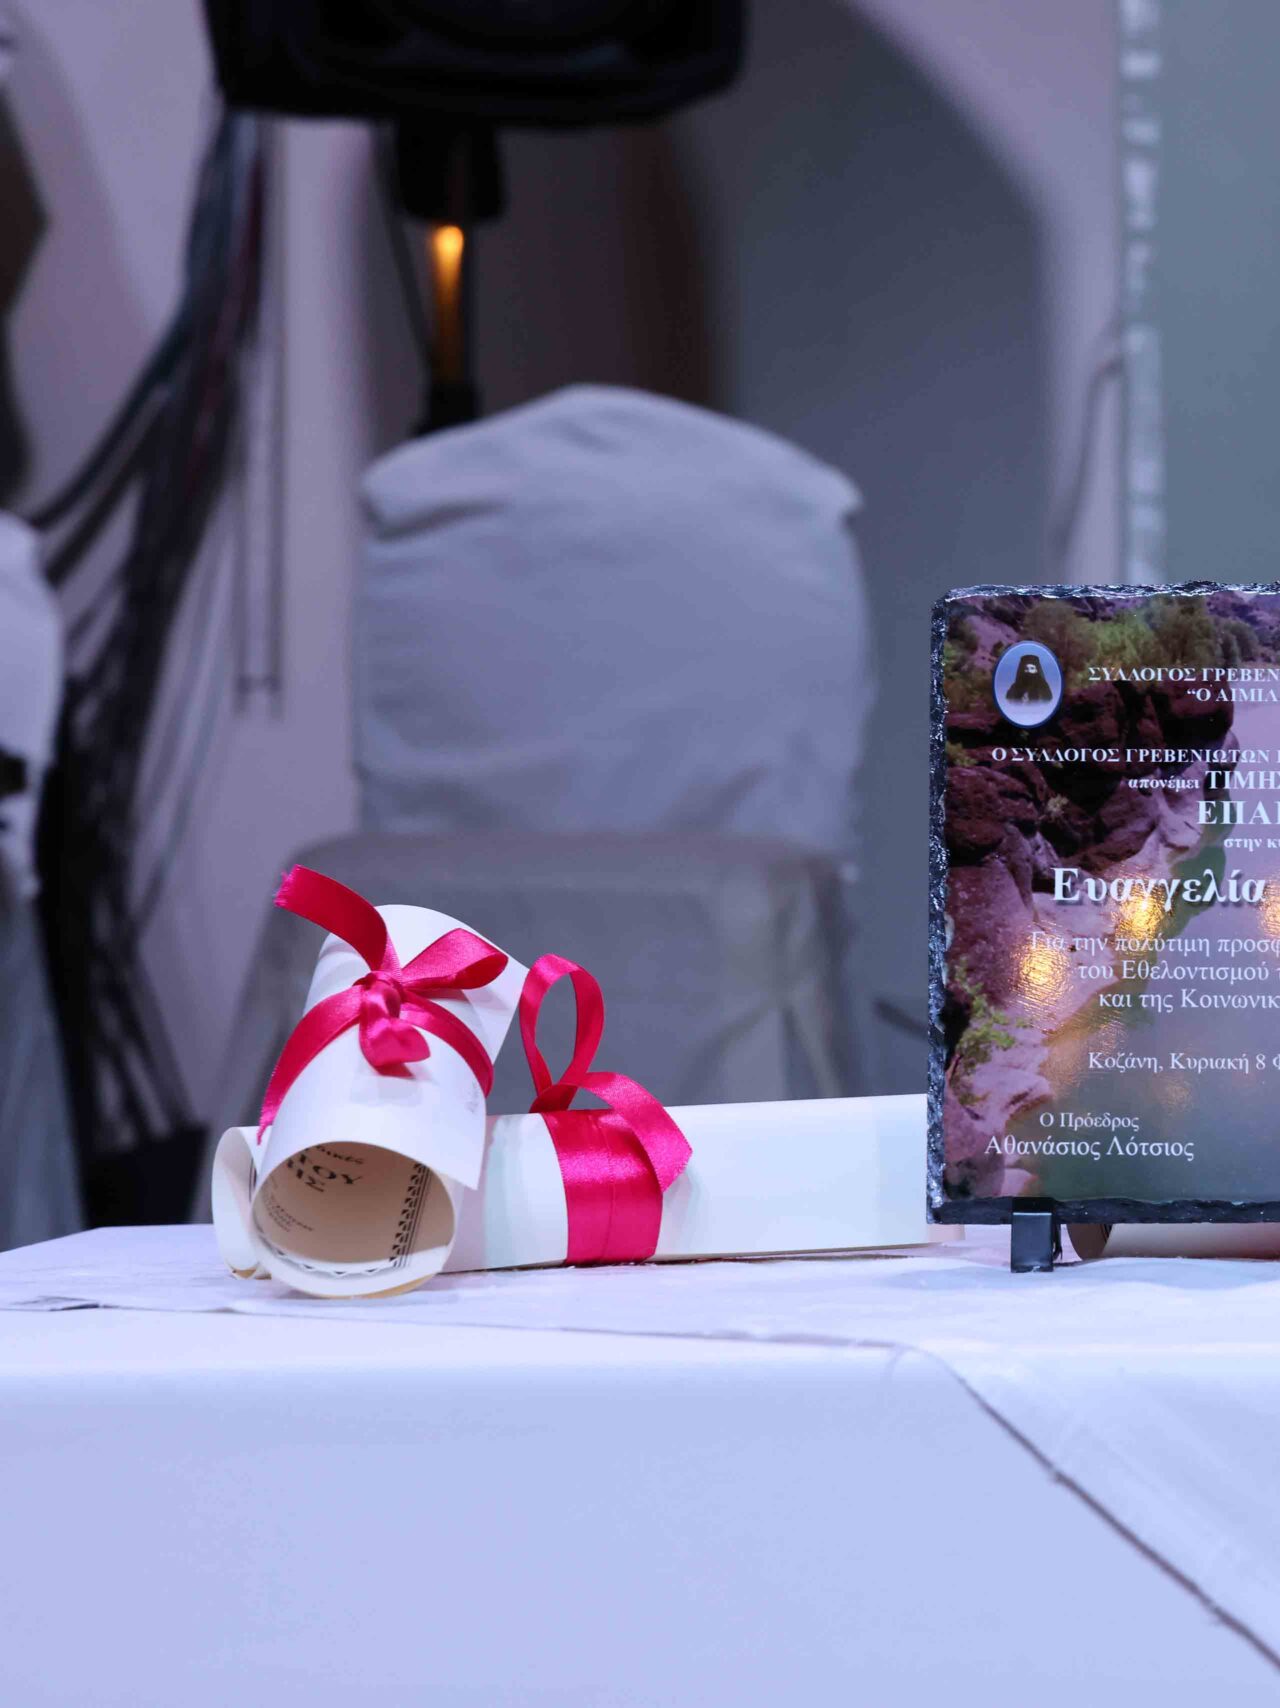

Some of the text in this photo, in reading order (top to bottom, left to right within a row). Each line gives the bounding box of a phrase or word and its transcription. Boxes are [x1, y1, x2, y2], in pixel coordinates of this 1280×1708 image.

[1088, 667, 1196, 682] ΣΥΛΛΟΓΟΣ
[1011, 748, 1120, 762] ΣΥΛΛΟΓΟΣ
[1125, 749, 1269, 763] ΓΡΕΒΕΝΙΩΤΩΝ
[1128, 775, 1199, 793] απονέμει
[1223, 838, 1262, 852] στην
[1030, 931, 1065, 950] Για
[1072, 937, 1108, 952] την
[1115, 933, 1210, 957] πολύτιμη
[1078, 964, 1114, 980] του
[1122, 960, 1269, 984] Εθελοντισμού
[1100, 992, 1132, 1008] και
[1139, 994, 1174, 1013] της
[1088, 1052, 1163, 1073] Κοζάνη,
[1169, 1053, 1250, 1074] Κυριακή
[1255, 1054, 1266, 1070] 8
[1060, 1112, 1139, 1131] Πρόεδρος
[984, 1134, 1194, 1161] Αθανάσιος Λότσιος
